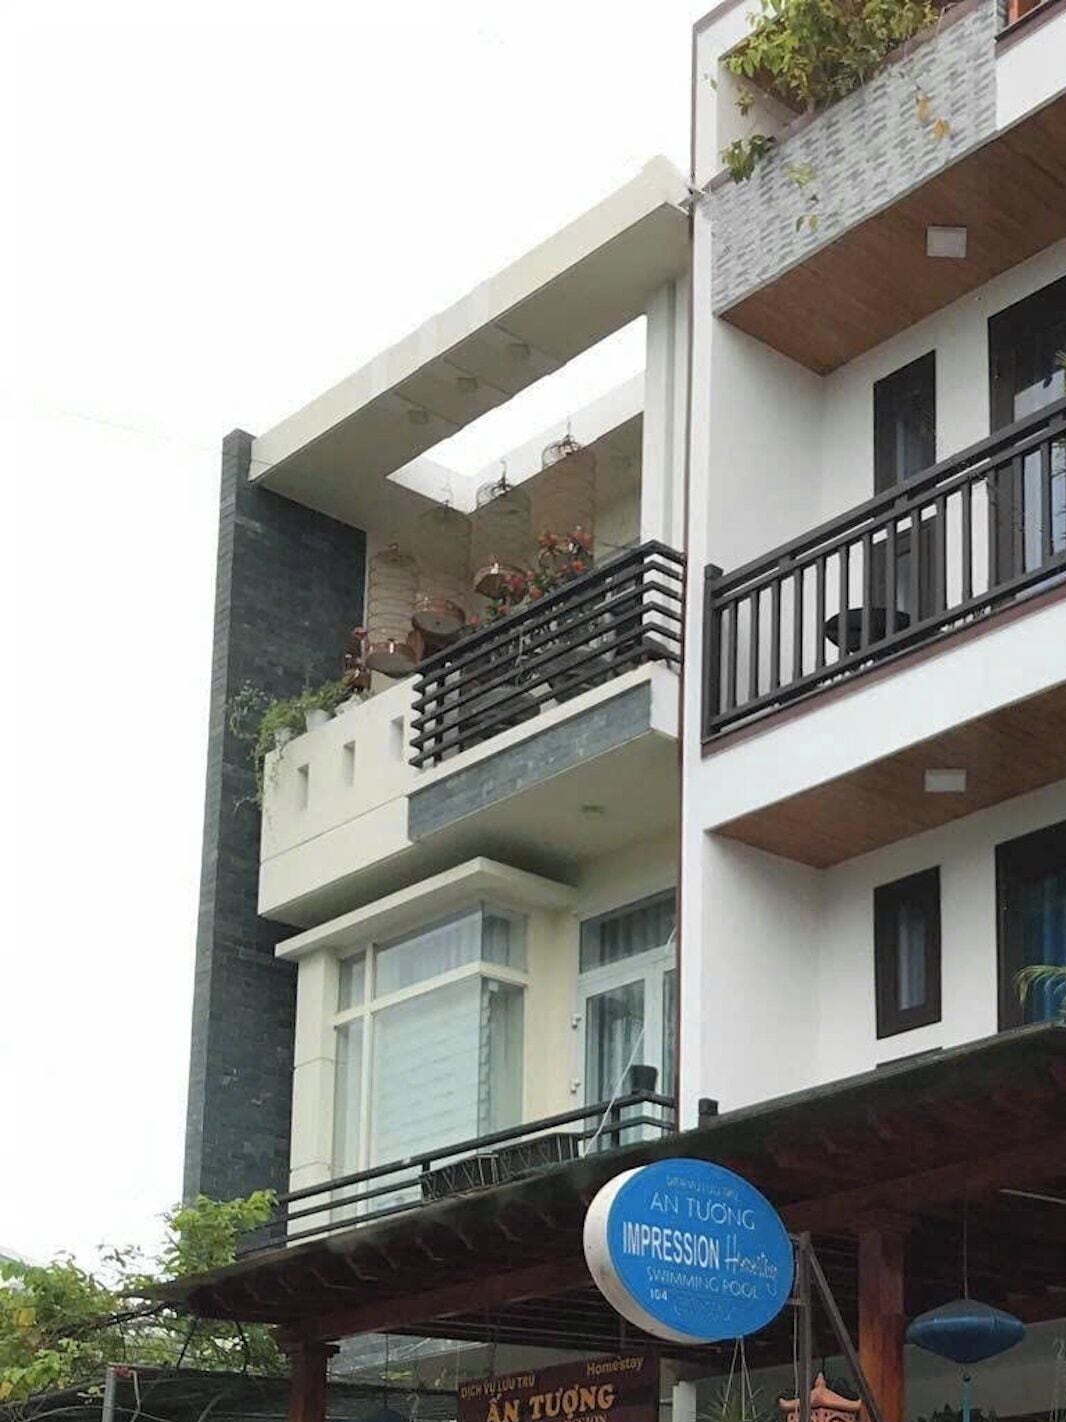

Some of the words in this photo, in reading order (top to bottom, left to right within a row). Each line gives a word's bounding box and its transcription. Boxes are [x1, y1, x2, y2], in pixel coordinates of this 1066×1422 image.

[622, 1221, 720, 1271] IMPRESSION
[646, 1266, 720, 1292] SWIMMING
[722, 1279, 759, 1299] POOL
[650, 1289, 668, 1301] 104
[587, 1356, 645, 1376] Homestay
[529, 1383, 616, 1420] TƯỢNG
